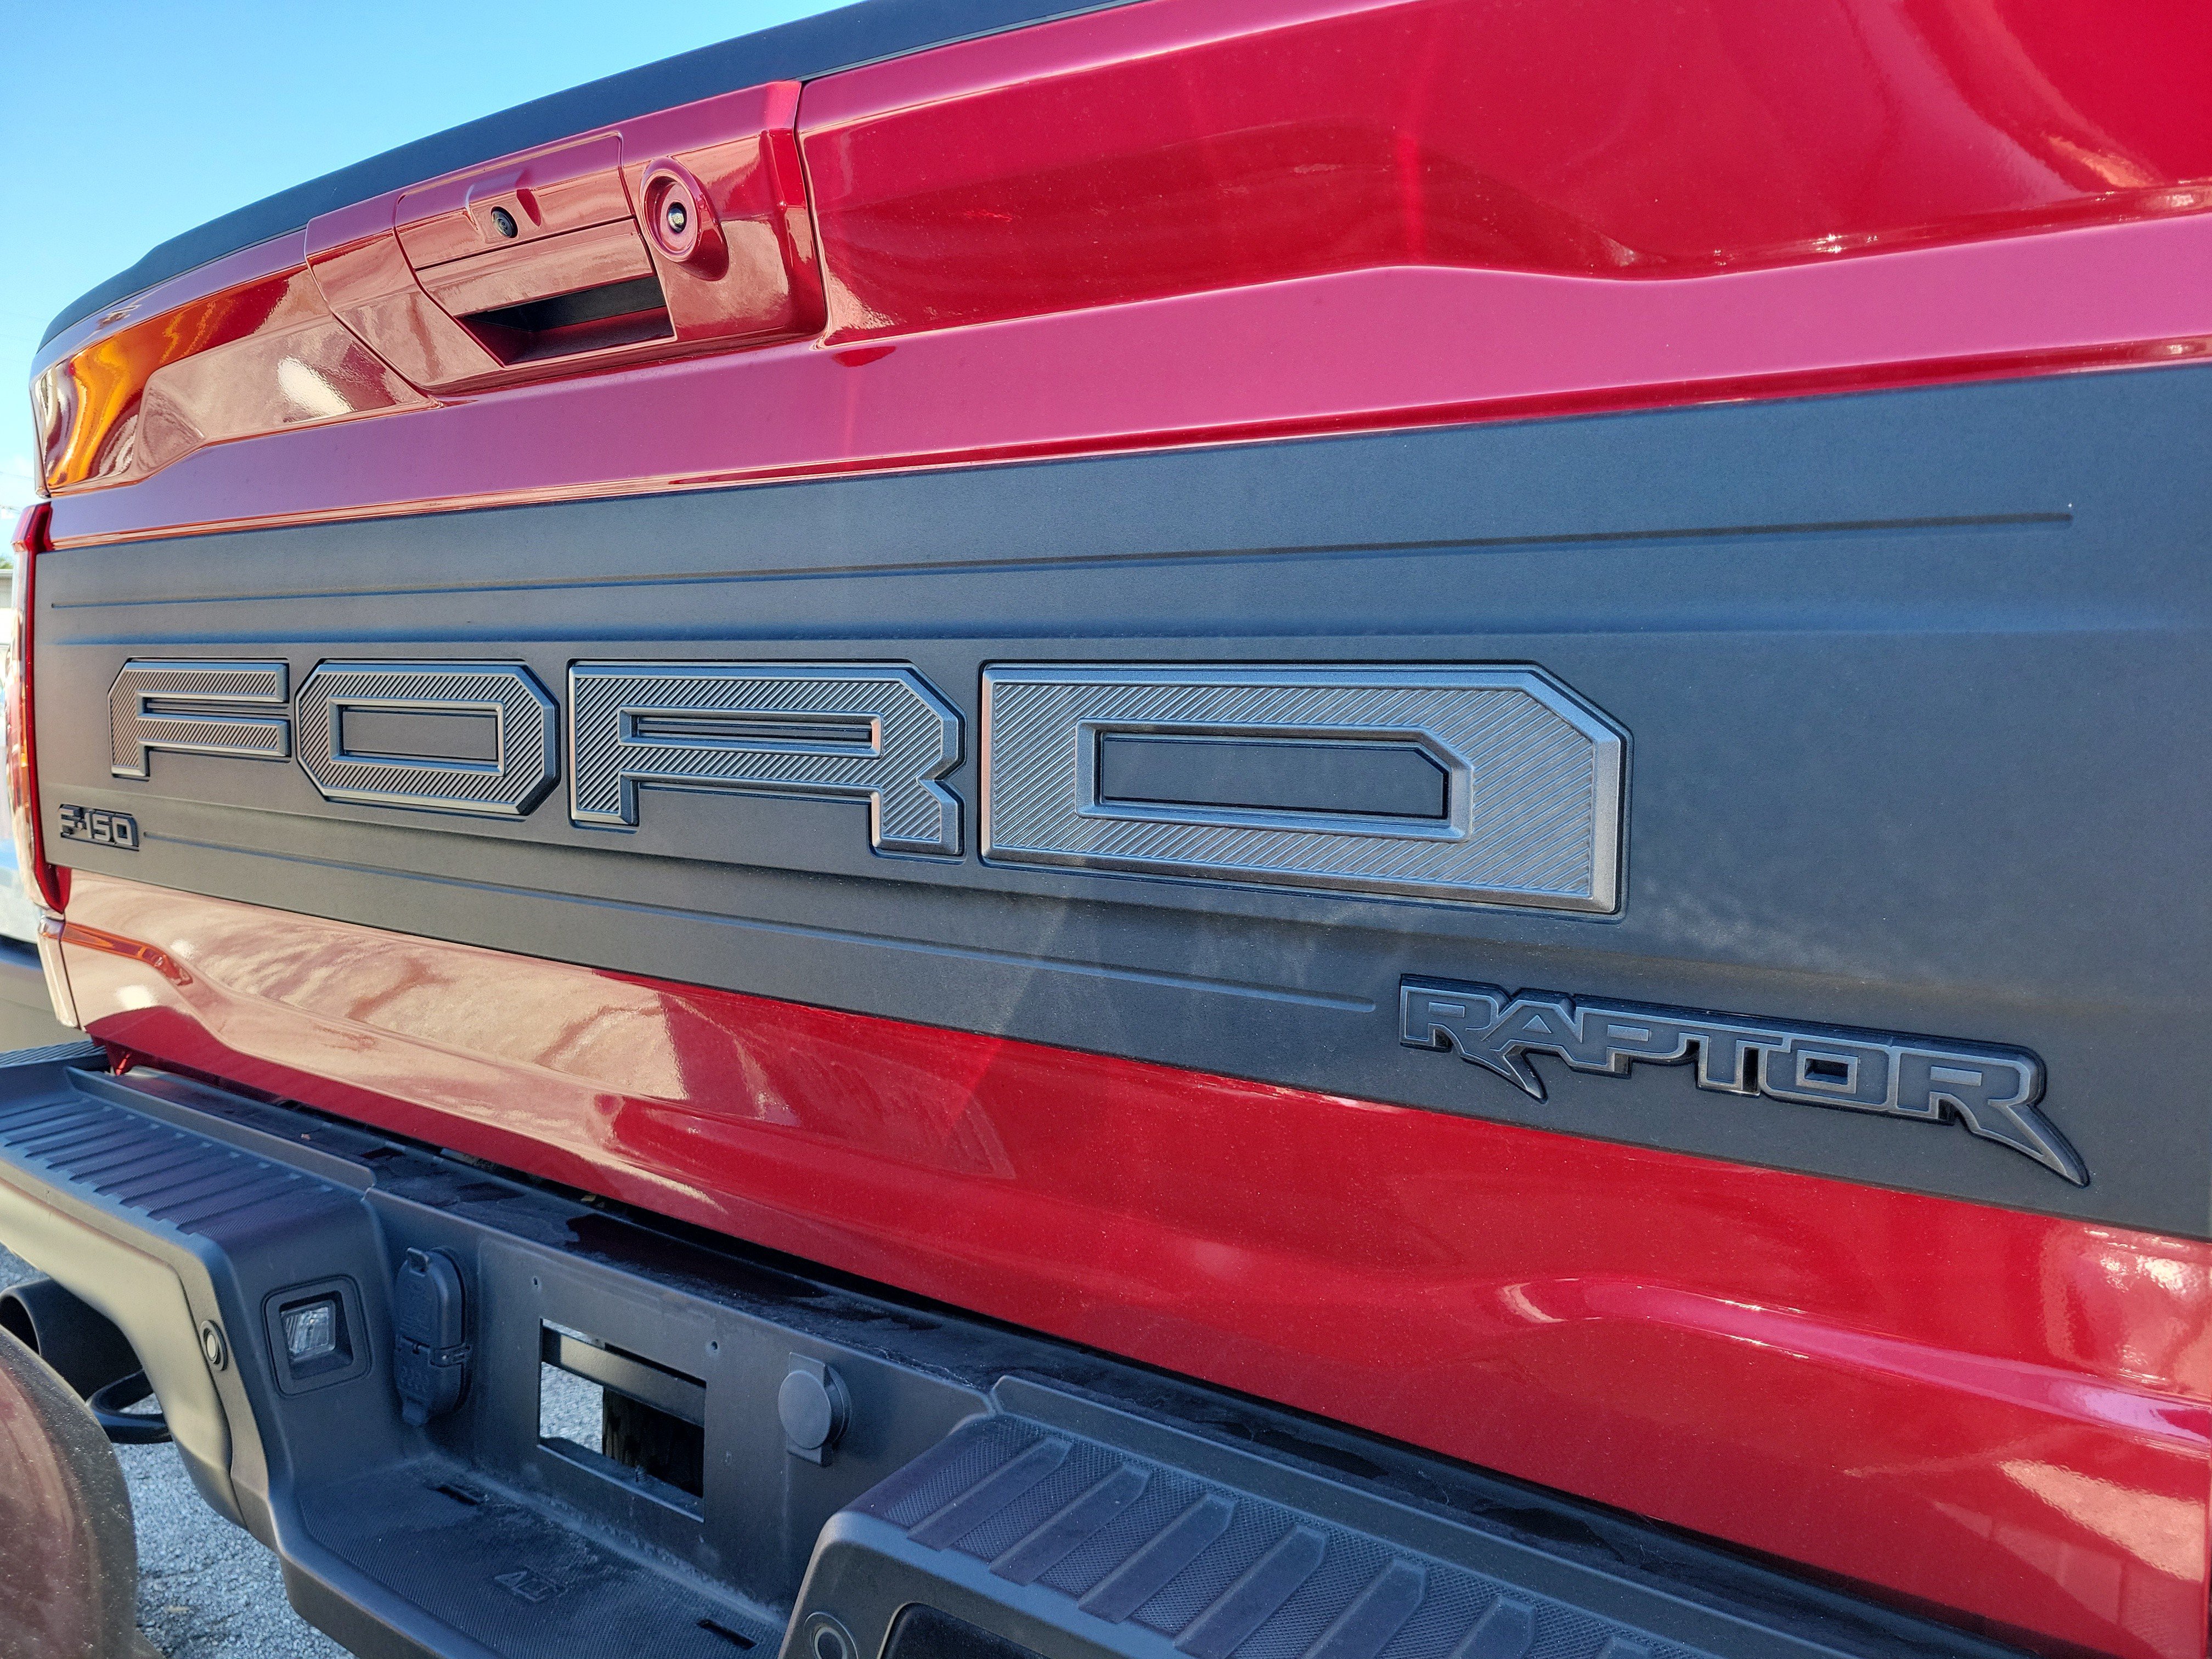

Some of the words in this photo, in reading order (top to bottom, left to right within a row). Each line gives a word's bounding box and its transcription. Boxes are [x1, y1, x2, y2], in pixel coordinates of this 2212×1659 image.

[59, 804, 139, 850] F-150
[108, 658, 1628, 917] FORD
[1400, 974, 2088, 1187] RAPTOR
